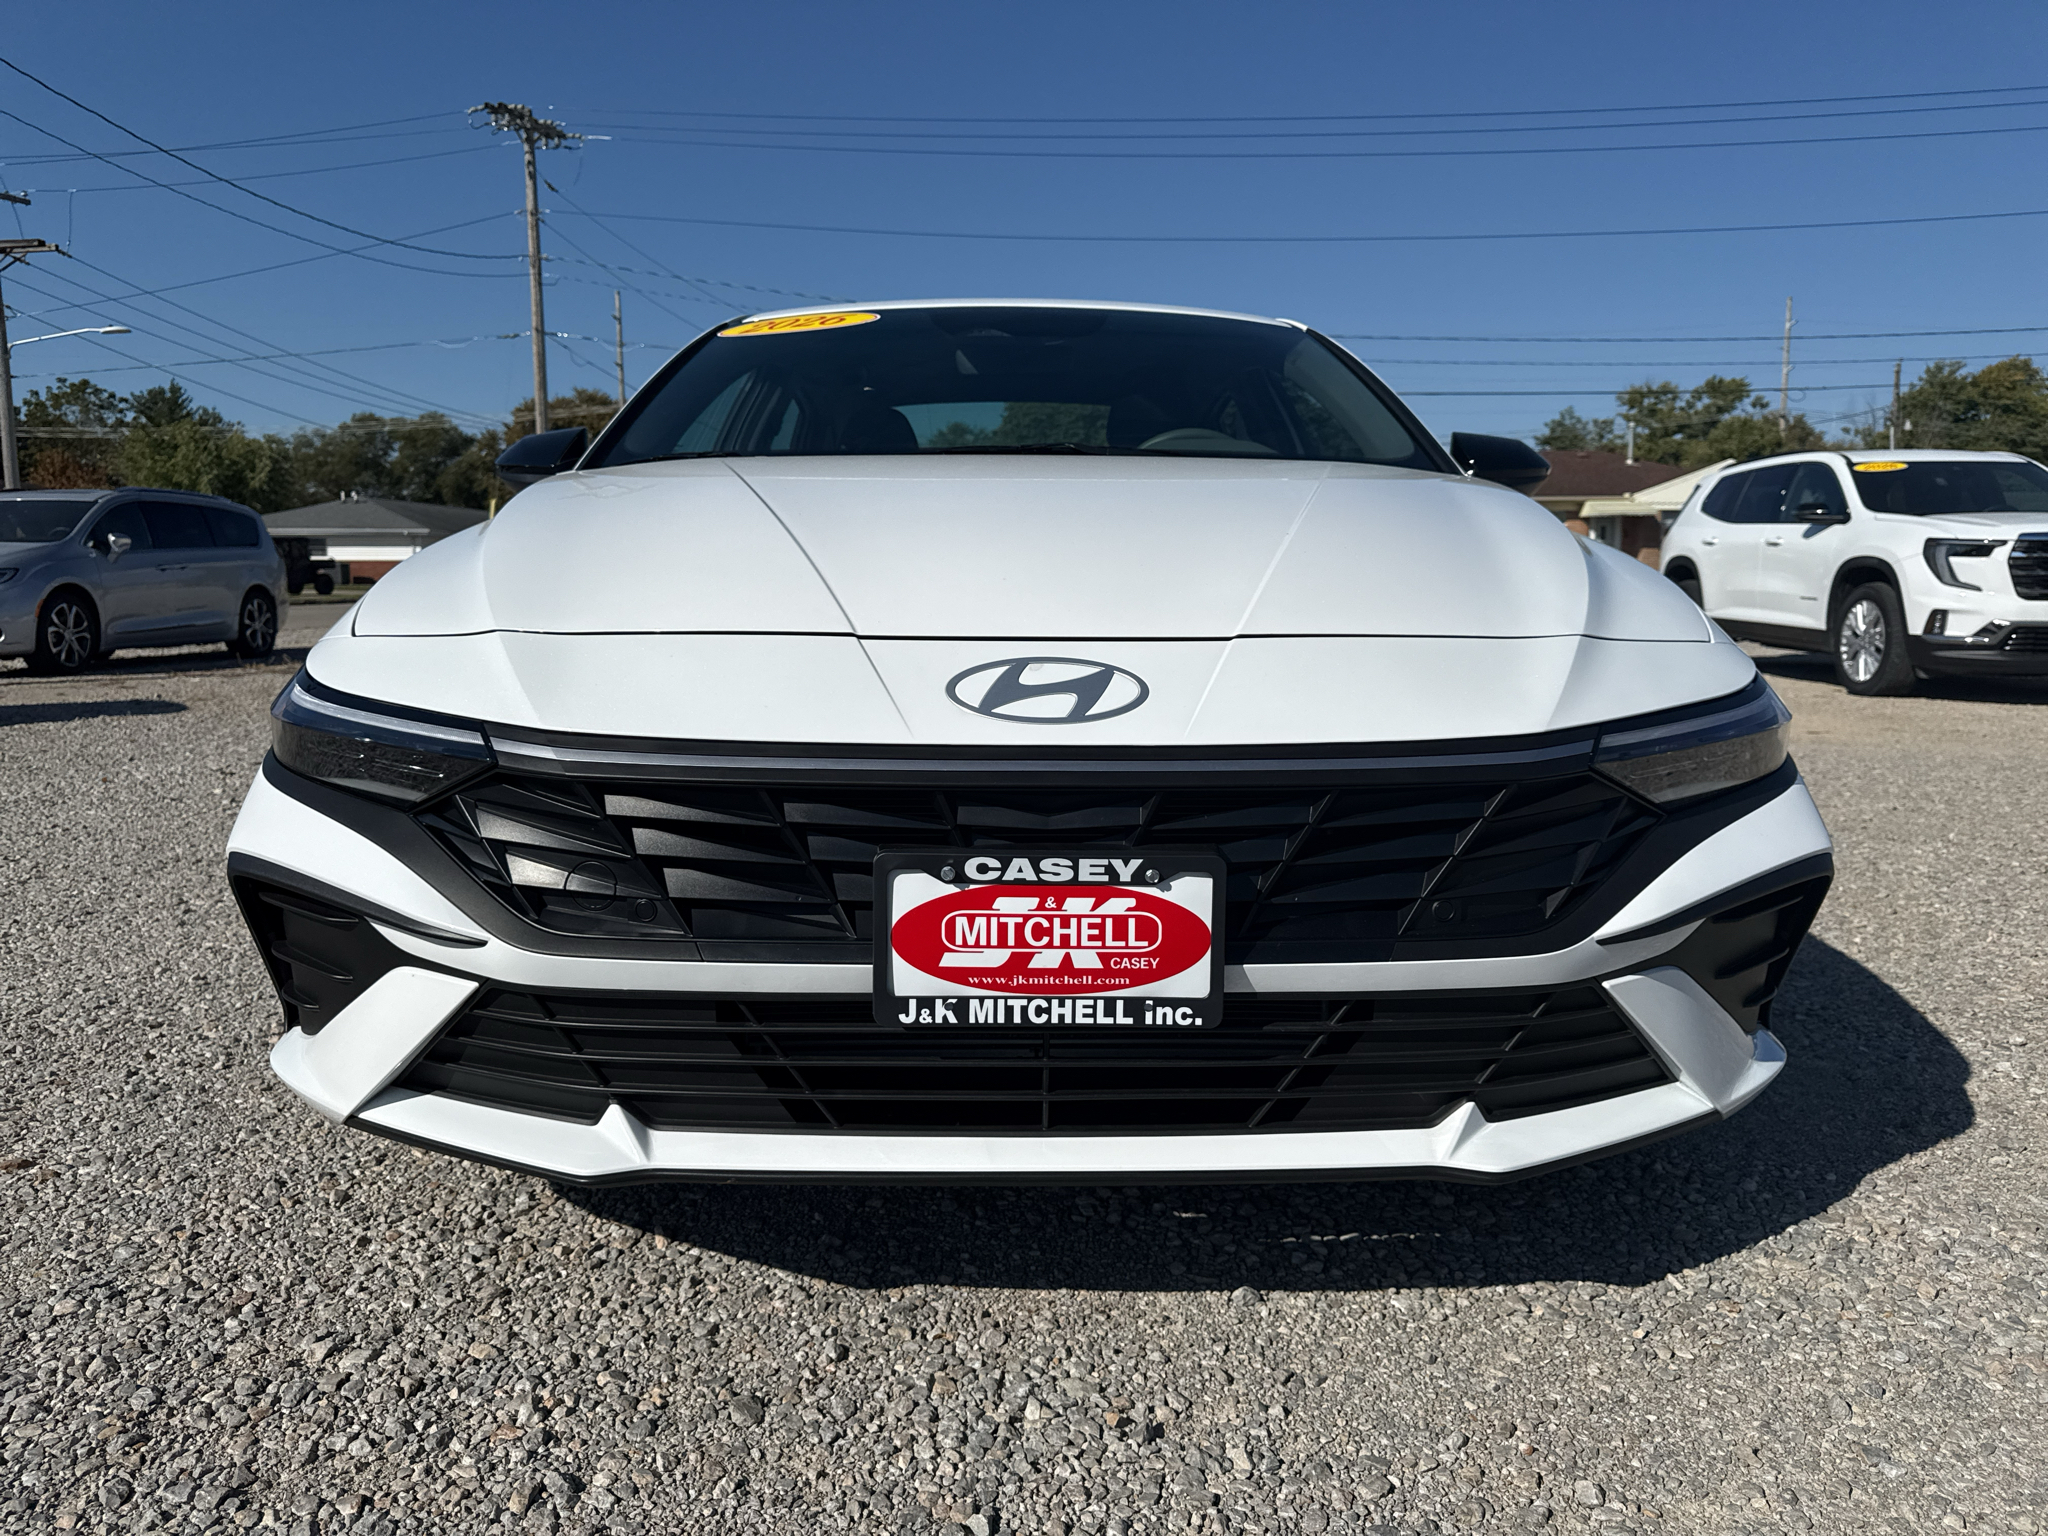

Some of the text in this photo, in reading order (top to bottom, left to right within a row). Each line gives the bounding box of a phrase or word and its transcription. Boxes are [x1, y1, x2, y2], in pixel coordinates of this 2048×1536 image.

[738, 313, 858, 335] 2026
[964, 857, 1144, 882] CASEY
[955, 916, 1149, 947] MITCHELL
[1110, 957, 1160, 969] CASEY
[967, 975, 1130, 986] www.jkmitchell.com
[898, 998, 958, 1024] J&K
[969, 998, 1134, 1025] MITCHELL
